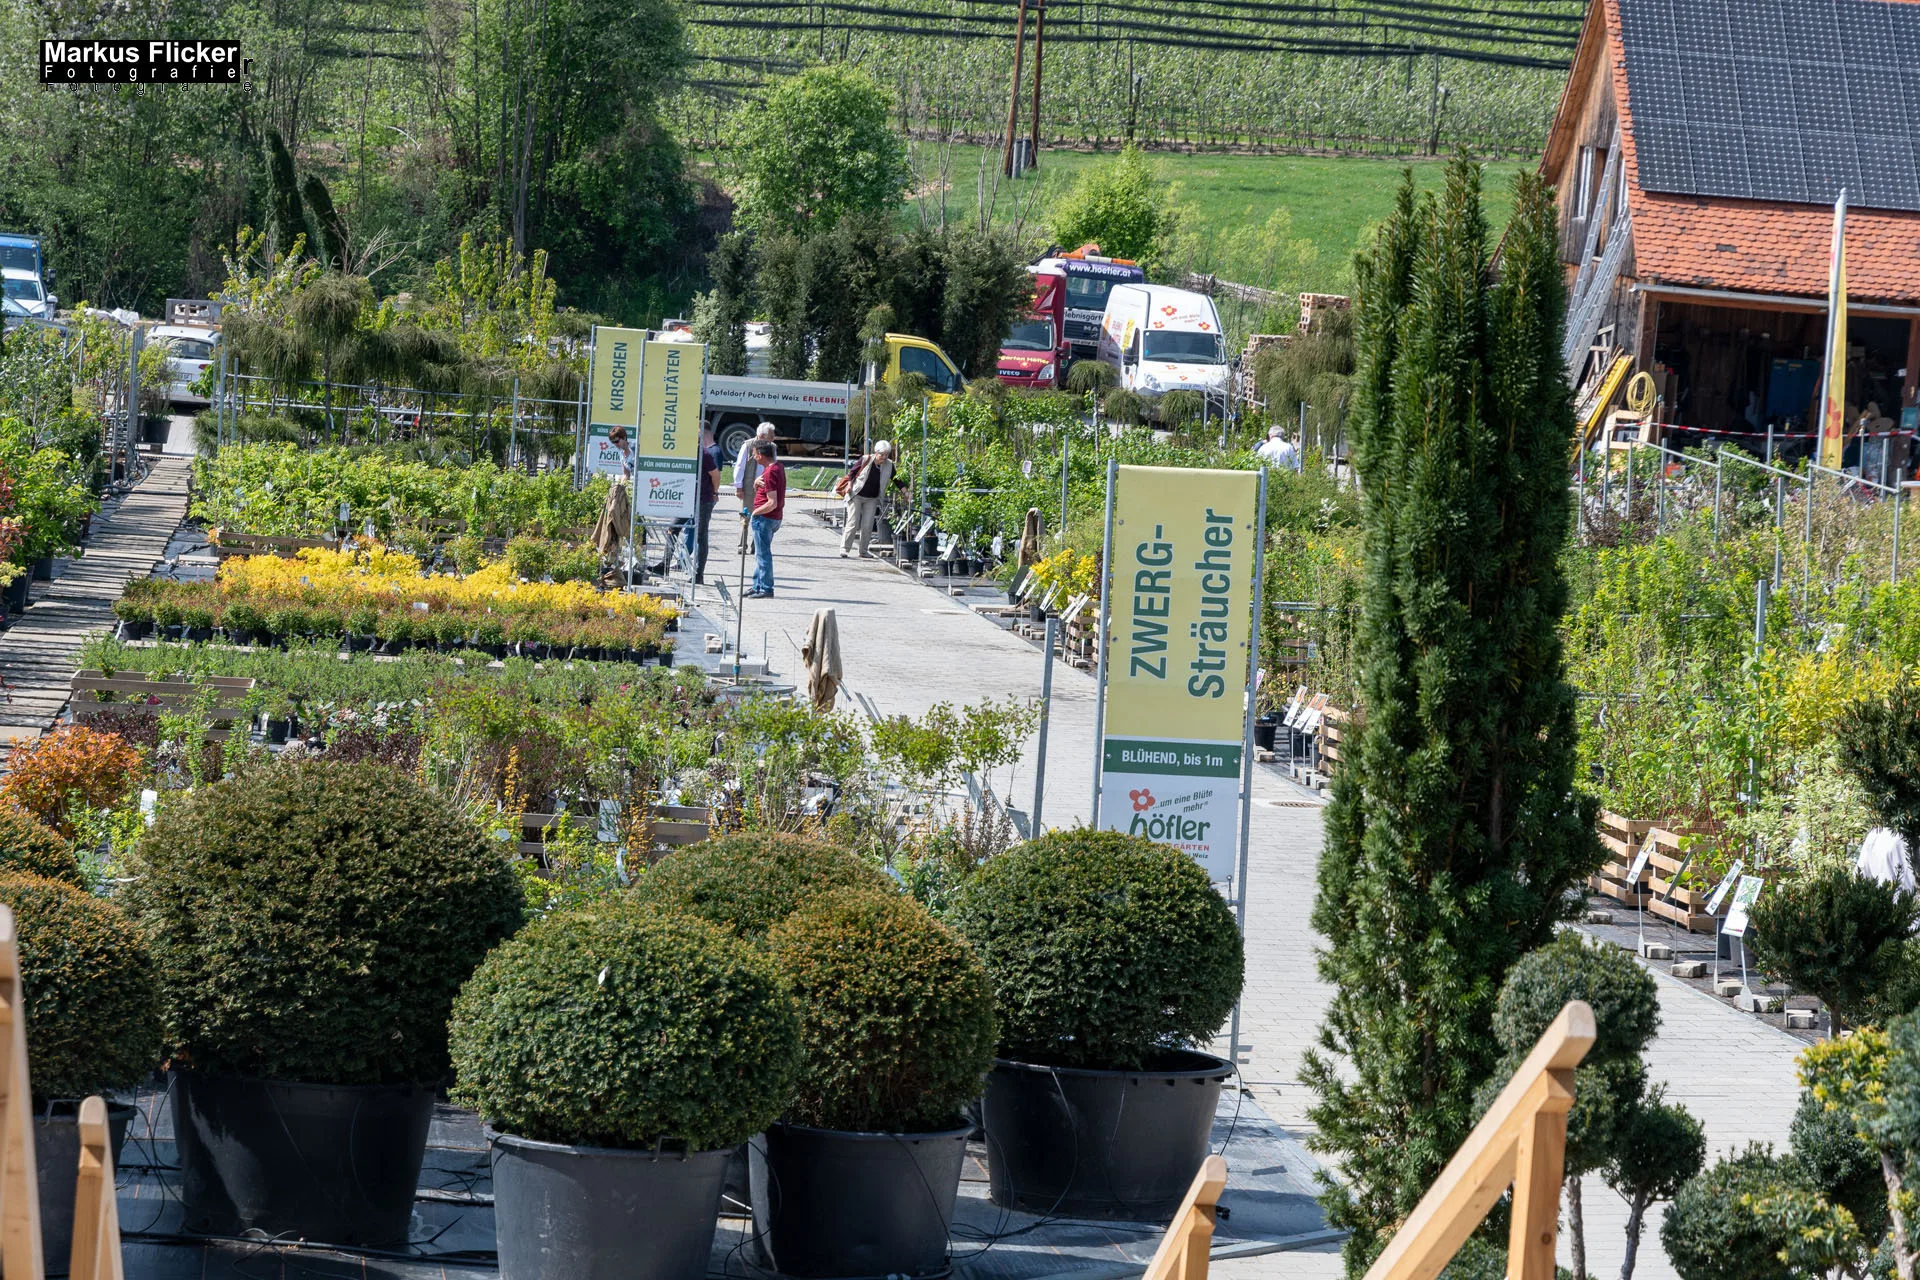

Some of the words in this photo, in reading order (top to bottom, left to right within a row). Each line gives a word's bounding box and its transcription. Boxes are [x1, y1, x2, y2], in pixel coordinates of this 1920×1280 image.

[1069, 264, 1132, 278] www.hoefler.at
[610, 341, 628, 412] KIRSCHEN
[662, 349, 681, 451] SPEZIALITÄTEN
[709, 388, 747, 400] Apfeldorf
[747, 391, 766, 400] Puch
[767, 392, 780, 401] bei
[781, 394, 800, 402] Weiz
[802, 395, 847, 405] ERLEBNIS
[643, 460, 655, 468] FÜR
[655, 461, 671, 469] IHREN
[671, 462, 693, 470] GARTEN
[648, 488, 685, 501] höfler
[1130, 524, 1175, 681] ZWERG-
[1186, 507, 1235, 700] Sträucher
[1121, 749, 1180, 766] BLÜHEND,
[1183, 752, 1202, 766] bis
[1205, 754, 1223, 767] 1m
[1174, 795, 1191, 805] eine
[1192, 789, 1213, 801] Blüte
[1129, 813, 1211, 840] höfler
